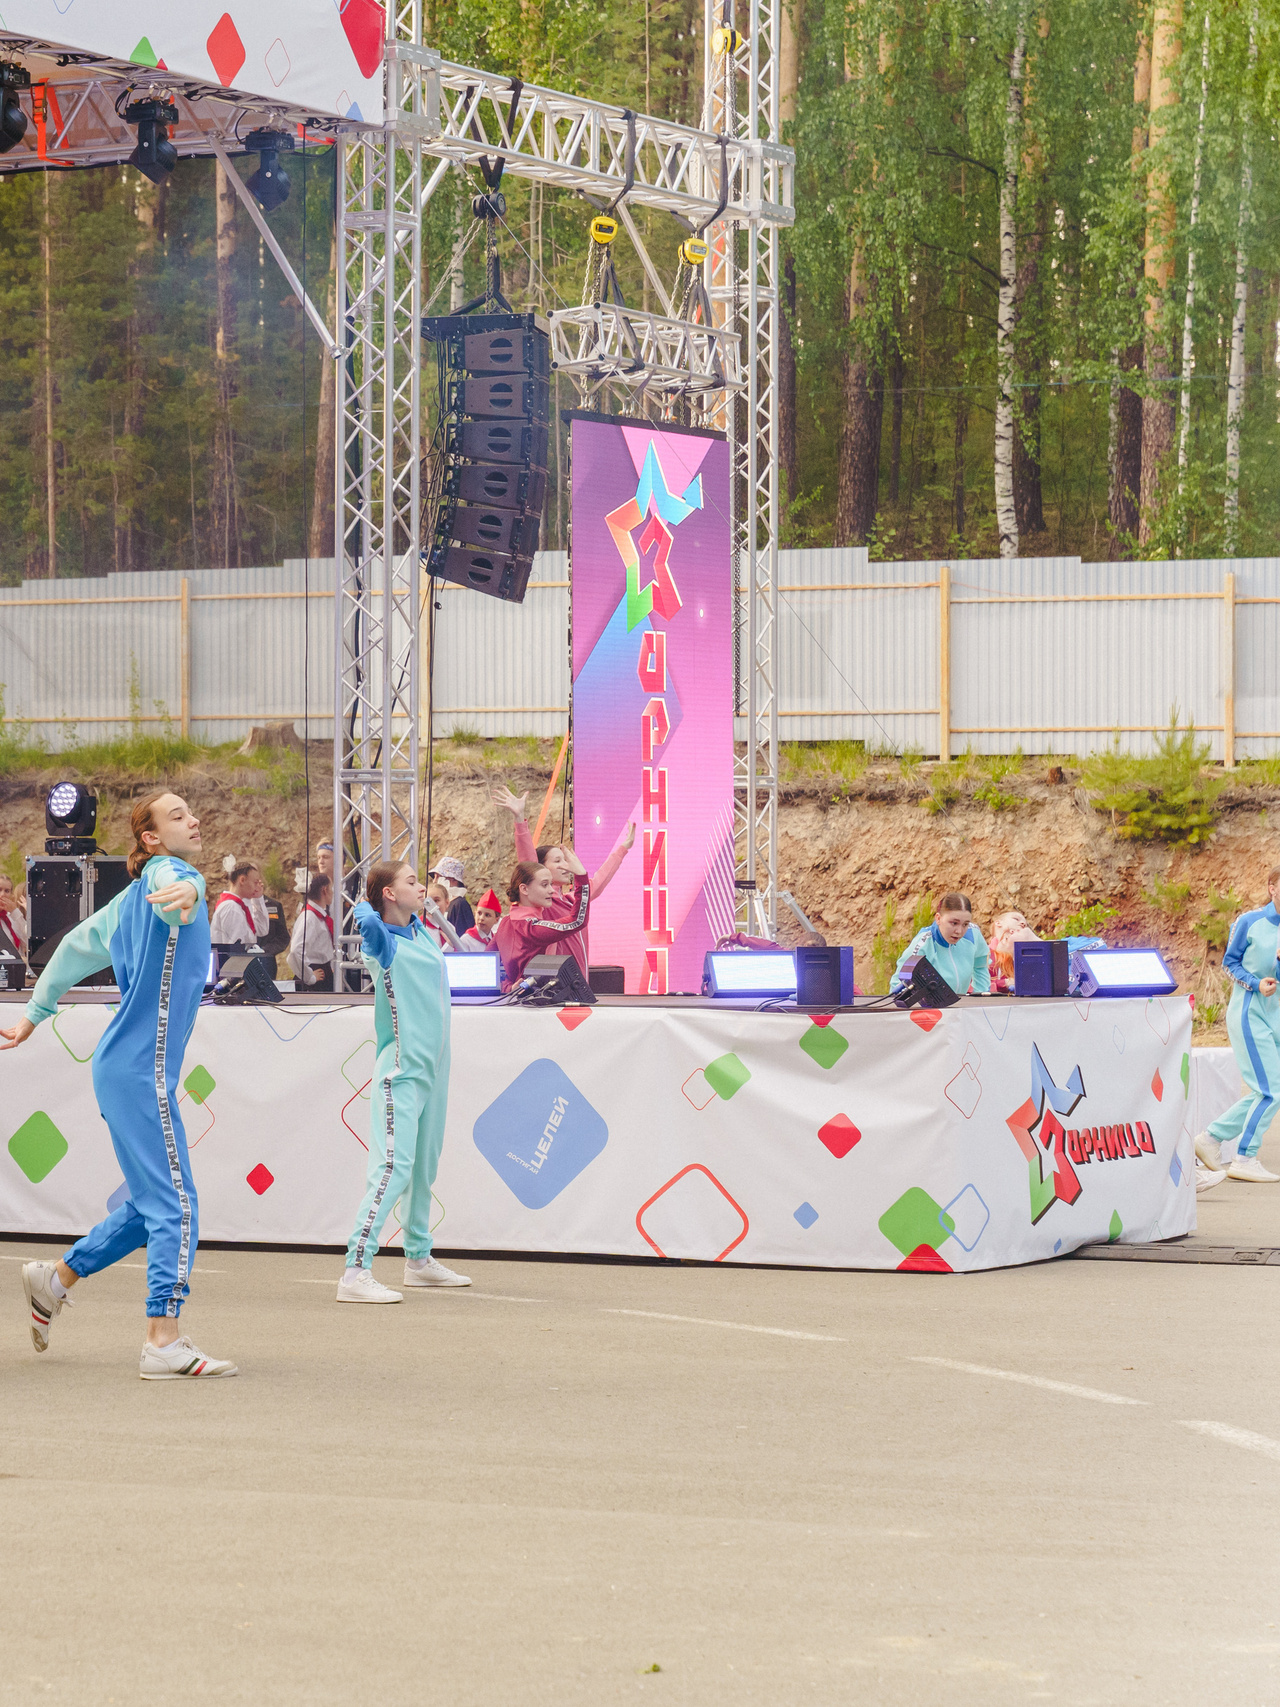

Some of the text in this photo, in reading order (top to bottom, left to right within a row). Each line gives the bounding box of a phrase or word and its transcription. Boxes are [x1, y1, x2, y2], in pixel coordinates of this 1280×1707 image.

[164, 936, 177, 971] BALLET
[160, 971, 171, 1011] APELSIN
[156, 1015, 167, 1051] BALLET
[155, 1053, 165, 1090] APELSIN
[159, 1097, 172, 1132] BALLET
[386, 1102, 394, 1136] APELSIN
[530, 1095, 569, 1170] ЦЕЛЕЙ
[165, 1132, 180, 1172] APELSIN
[384, 1148, 394, 1175] BALLET
[373, 1174, 391, 1206] APELSIN
[181, 1211, 191, 1249] APELSIN
[361, 1209, 376, 1238] BALLET
[355, 1238, 367, 1268] APELSIN
